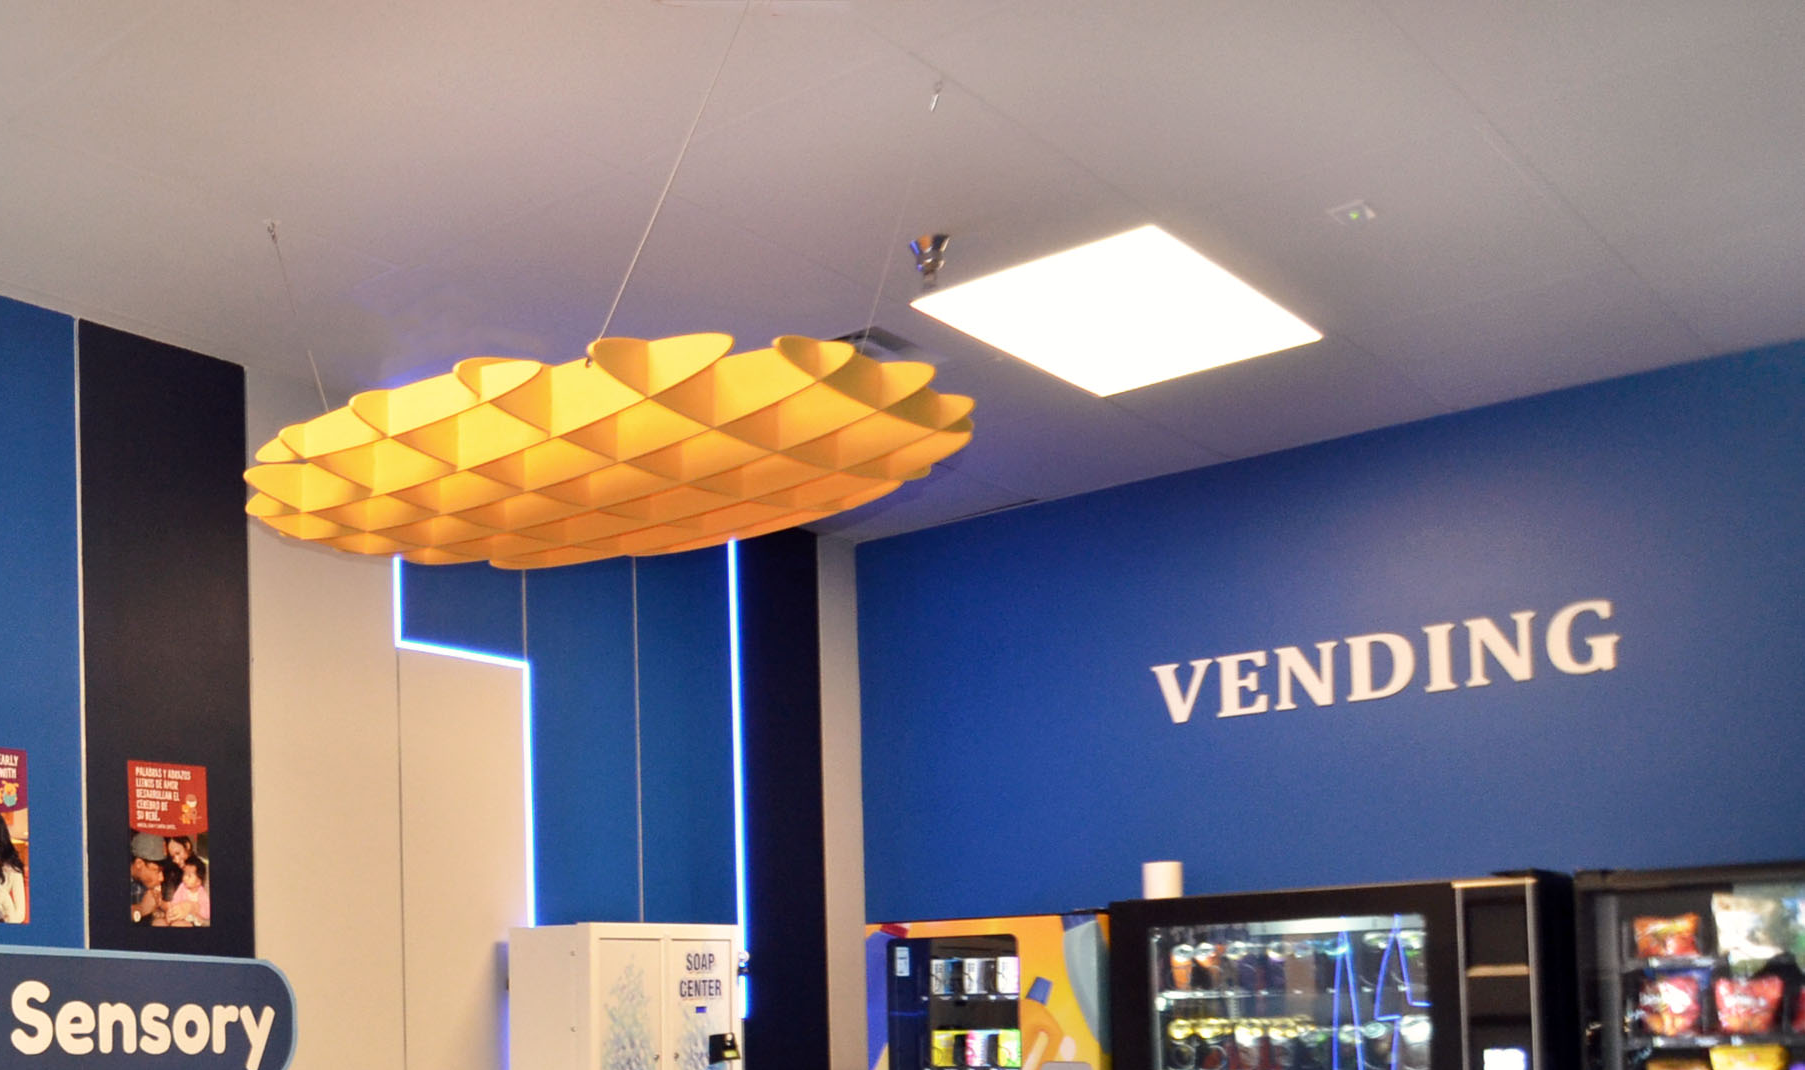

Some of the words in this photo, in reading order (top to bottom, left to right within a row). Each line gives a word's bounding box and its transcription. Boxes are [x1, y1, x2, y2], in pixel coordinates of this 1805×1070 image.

[1150, 600, 1620, 723] VENDING
[0, 766, 17, 779] WITH
[686, 953, 715, 971] SOAP
[679, 979, 722, 998] CENTER
